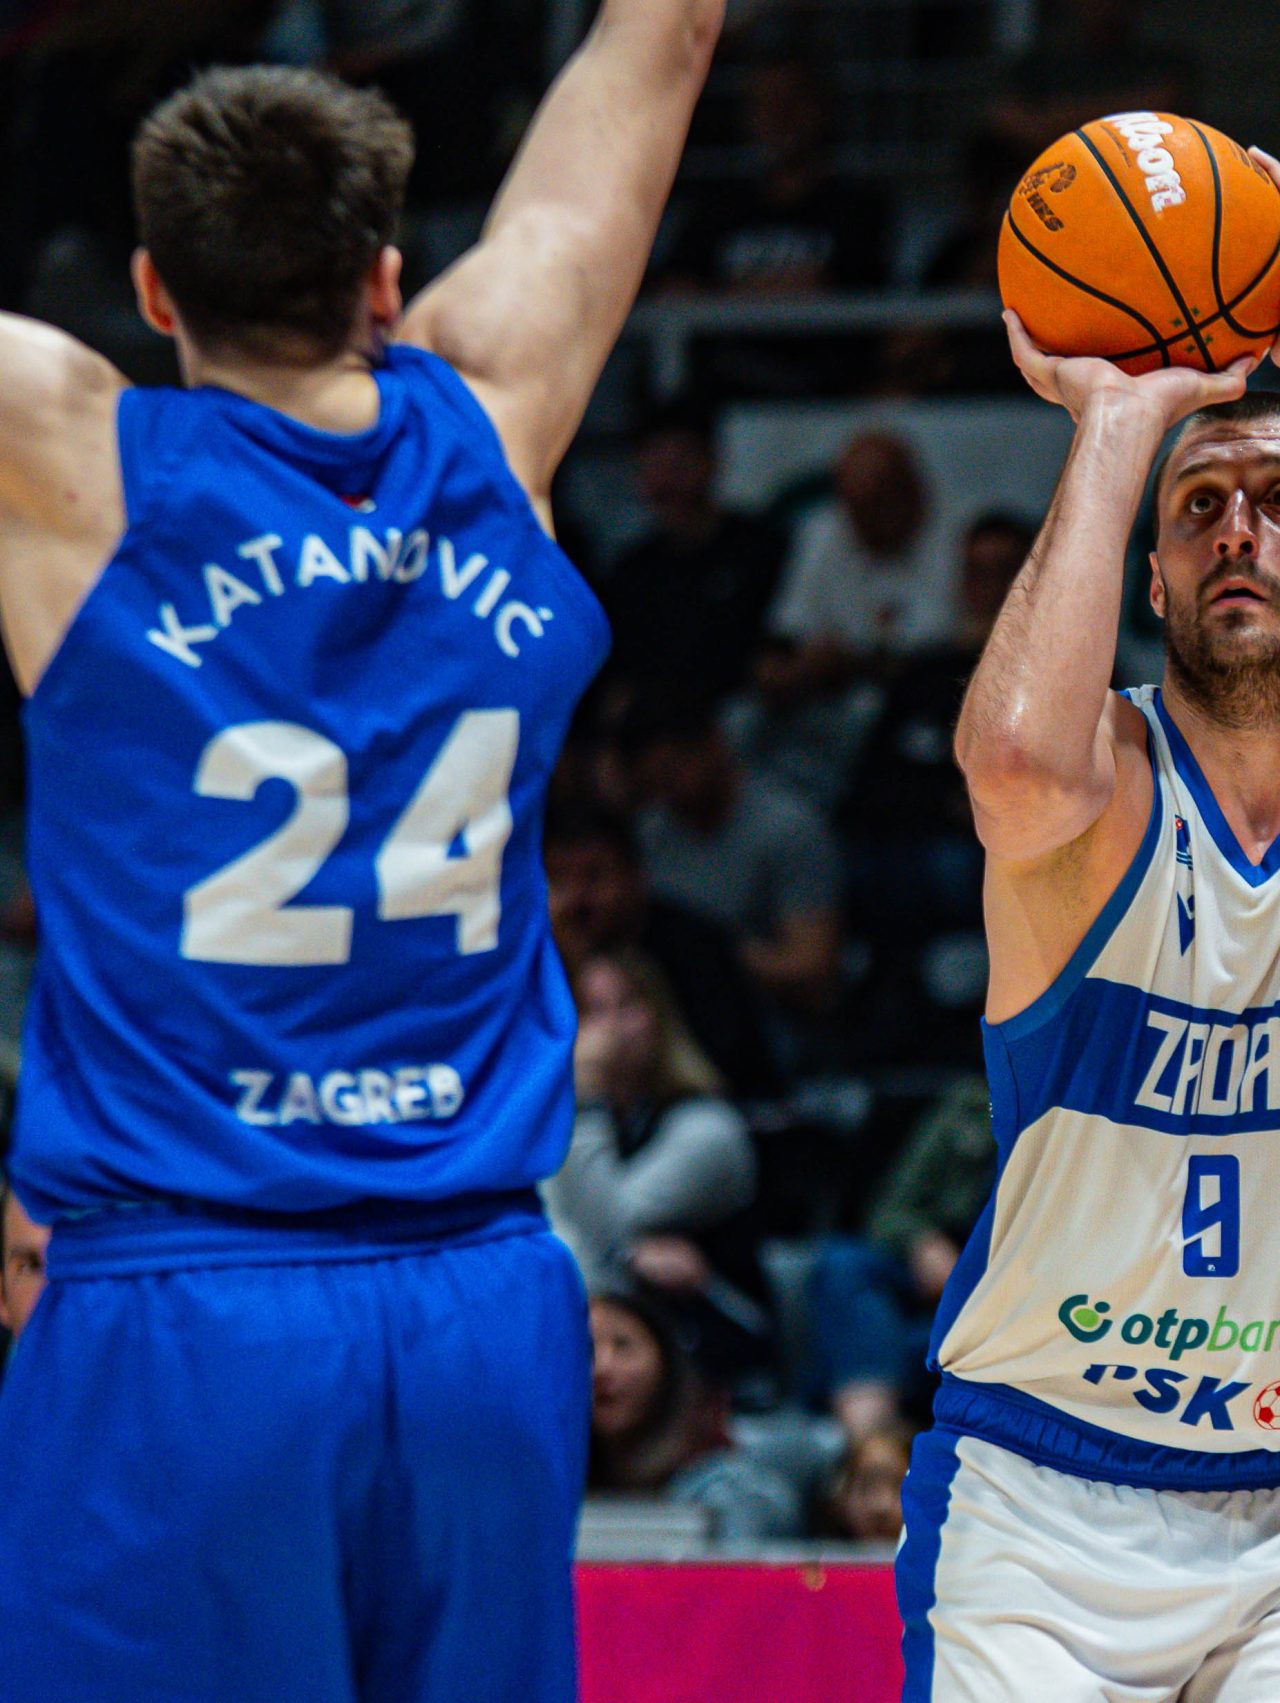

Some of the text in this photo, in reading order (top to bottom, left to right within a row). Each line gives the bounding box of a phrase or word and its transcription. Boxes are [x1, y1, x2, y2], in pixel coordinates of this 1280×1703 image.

[147, 528, 554, 668] KATANOVIĆ
[179, 707, 520, 965] 24
[231, 1063, 465, 1127] ZAGREB
[1182, 1154, 1240, 1278] 9
